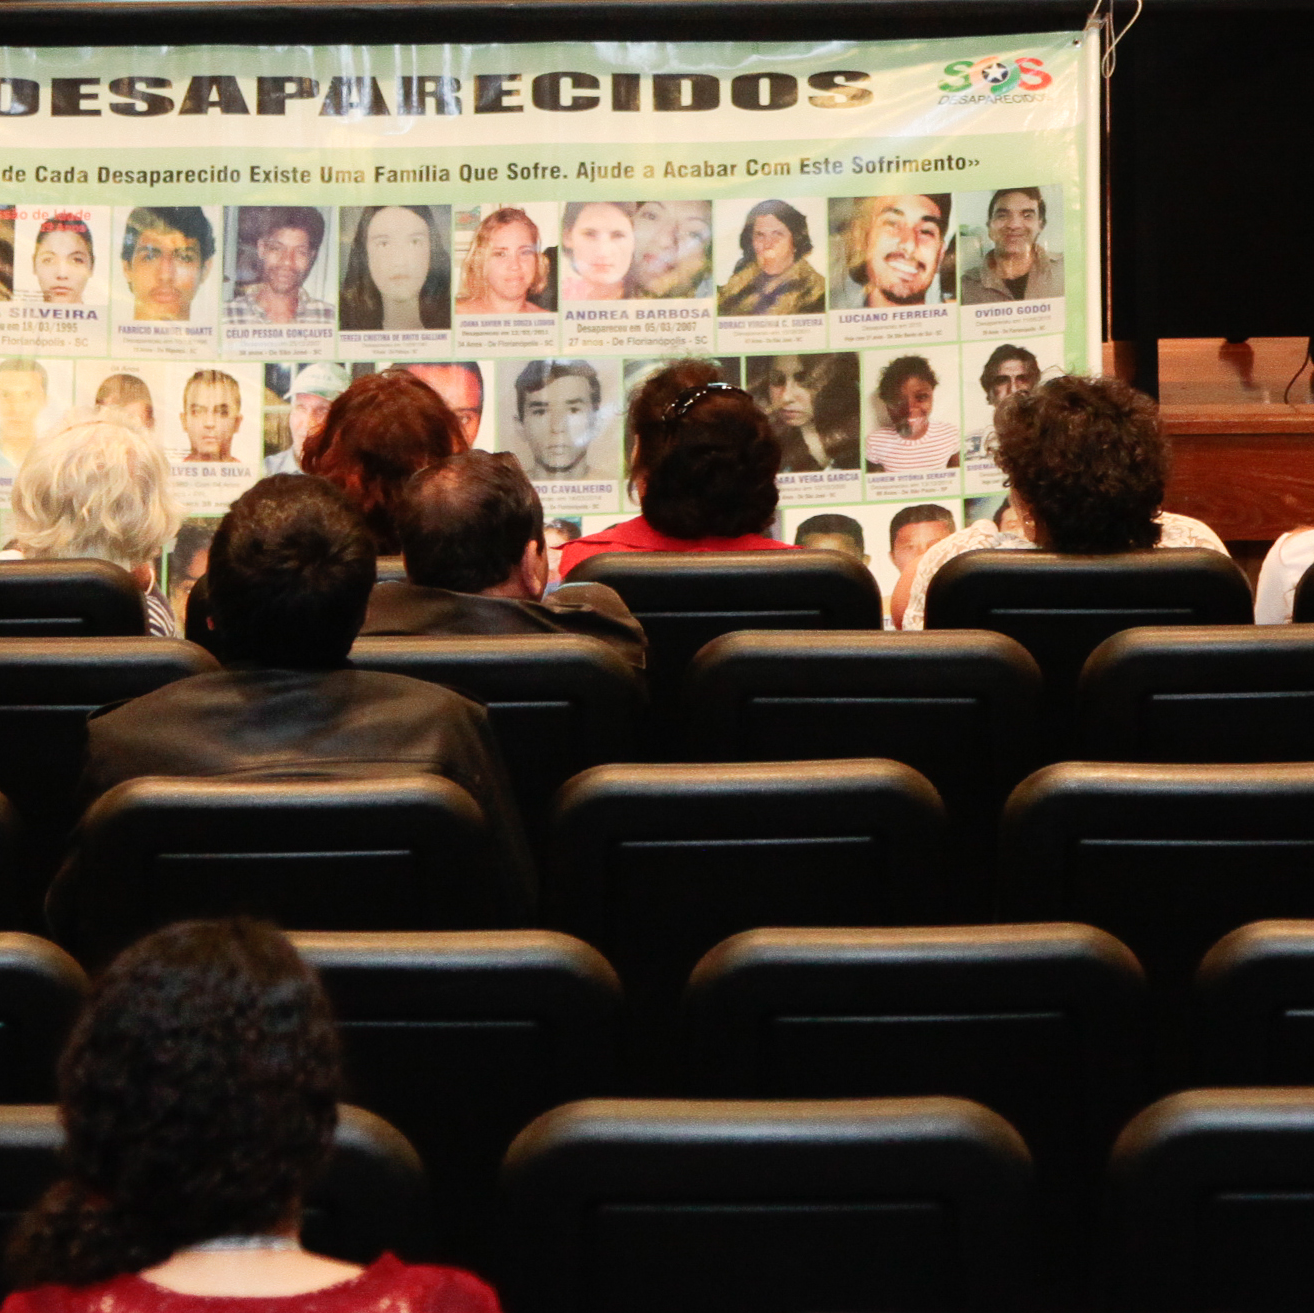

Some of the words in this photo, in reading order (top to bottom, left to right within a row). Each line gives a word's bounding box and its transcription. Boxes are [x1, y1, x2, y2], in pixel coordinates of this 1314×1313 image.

[939, 56, 1053, 96] SOS
[2, 165, 26, 183] de
[35, 165, 88, 183] Cada
[98, 165, 240, 187] Desaparecido
[250, 165, 311, 184] Existe
[320, 166, 365, 184] Uma
[375, 164, 450, 184] Família
[459, 163, 498, 184] Que
[507, 162, 567, 180] Sofre.
[577, 161, 635, 183] Ajude
[643, 164, 655, 178] a
[664, 161, 736, 178] Acabar
[746, 158, 790, 176] Com
[800, 157, 843, 175] Este
[33, 209, 49, 220] de
[55, 209, 91, 221] Idade
[9, 307, 99, 320] SILVEIRA
[565, 309, 630, 321] ANDREA
[636, 308, 711, 320] BARBOSA
[839, 313, 888, 323] LUCIANO
[893, 309, 948, 320] FERREIRA
[975, 307, 1013, 318] OVÍDIO
[7, 323, 19, 332] em
[23, 322, 78, 334] 18/03/1995
[252, 329, 283, 338] PESSOA
[286, 329, 333, 339] GONÇALVES
[577, 323, 628, 334] Desapareceu
[633, 324, 642, 332] em
[645, 322, 697, 332] 05/03/2007
[1, 336, 66, 348] Florianópolis
[75, 338, 88, 347] SC
[568, 338, 579, 347] 27
[581, 338, 604, 347] anos
[613, 337, 625, 346] De
[627, 336, 686, 348] Florianópolis
[695, 336, 708, 345] SC
[202, 468, 216, 476] DA
[221, 467, 251, 477] SILVA
[799, 475, 824, 483] VEIGA
[827, 473, 859, 483] GARCIA
[551, 485, 612, 493] CAVALHEIRO
